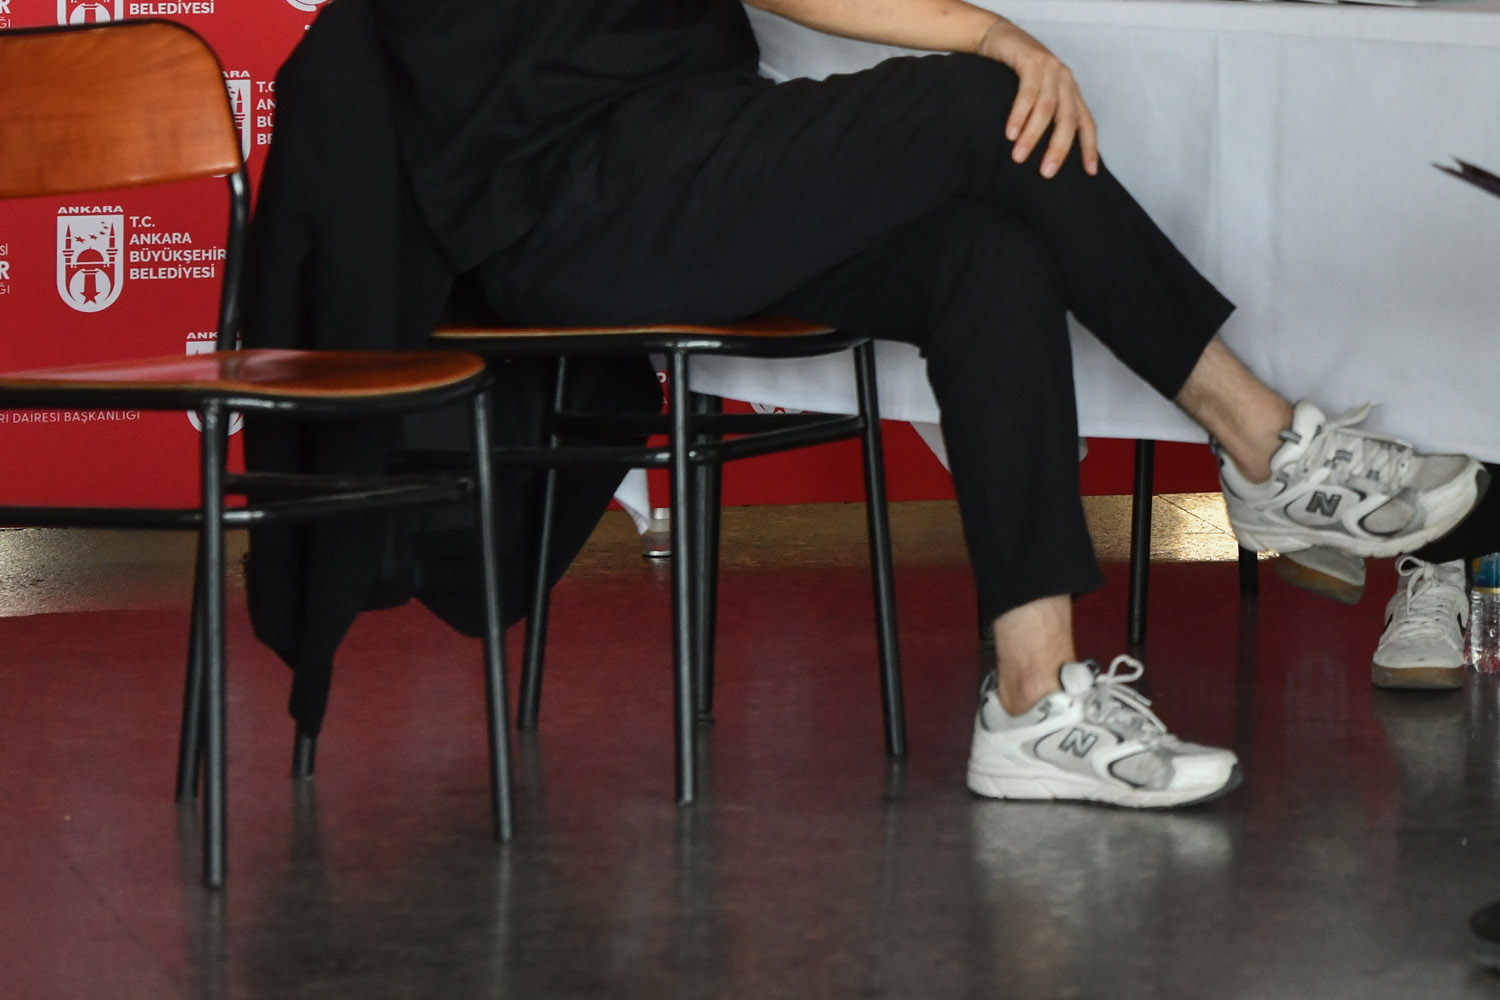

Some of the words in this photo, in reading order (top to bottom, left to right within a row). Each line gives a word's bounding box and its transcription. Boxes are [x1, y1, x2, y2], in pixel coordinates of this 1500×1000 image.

[129, 0, 214, 15] BELEDİYESİ
[57, 206, 124, 214] ANKARA
[129, 216, 155, 228] T.C.
[129, 232, 191, 245] ANKARA
[129, 246, 227, 264] BÜYÜKŞEHİR
[129, 263, 215, 280] BELEDİYESİ
[1305, 490, 1342, 518] N
